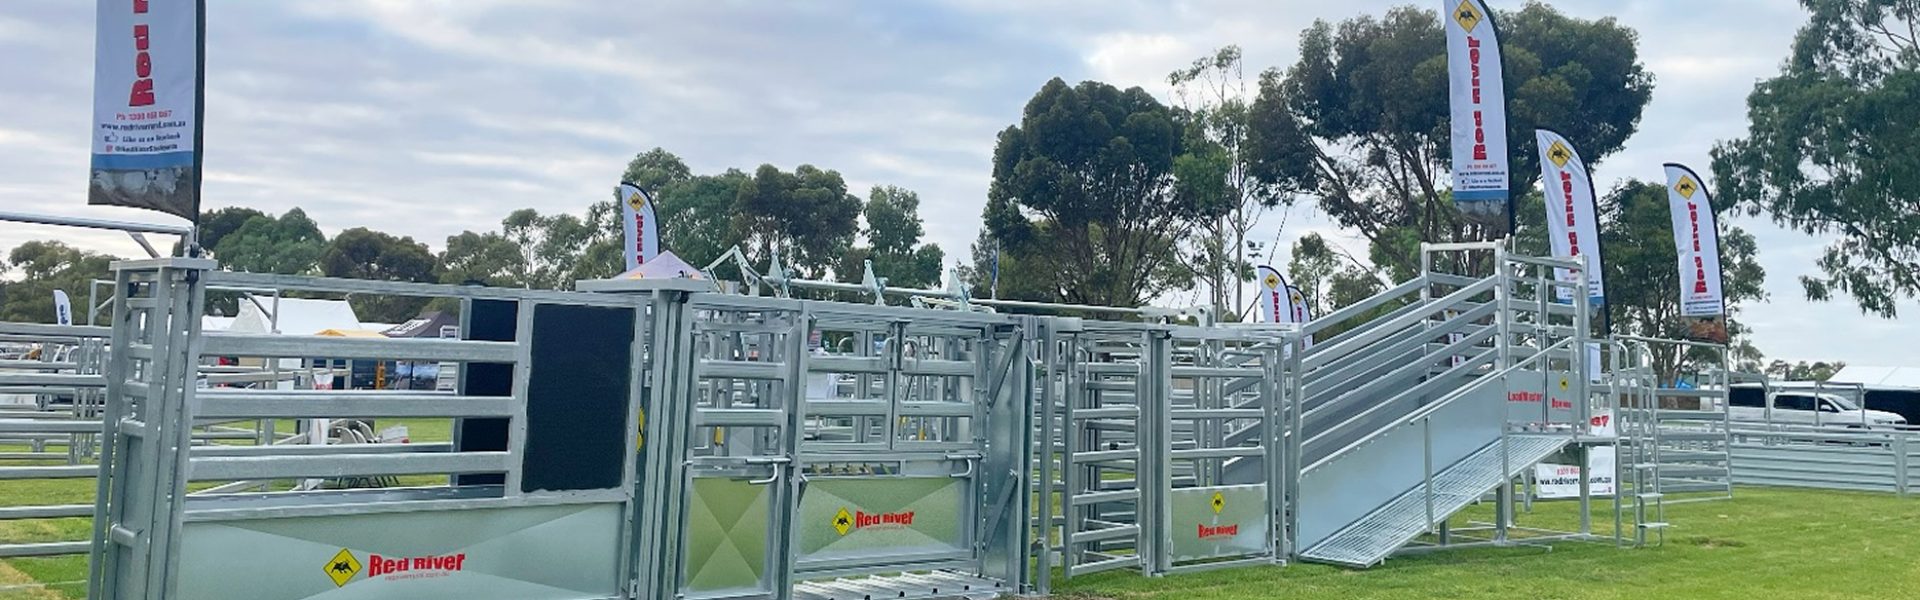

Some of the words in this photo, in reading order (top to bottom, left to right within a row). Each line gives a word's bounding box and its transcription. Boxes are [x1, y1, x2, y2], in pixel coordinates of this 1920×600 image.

[128, 24, 155, 107] Red
[1466, 35, 1481, 105] River
[1473, 110, 1488, 161] Red
[1560, 170, 1575, 227] River
[1687, 201, 1701, 252] River
[1694, 256, 1708, 294] Red
[856, 510, 880, 529] Red
[883, 512, 914, 525] River
[368, 554, 409, 578] Red
[413, 553, 466, 572] River
